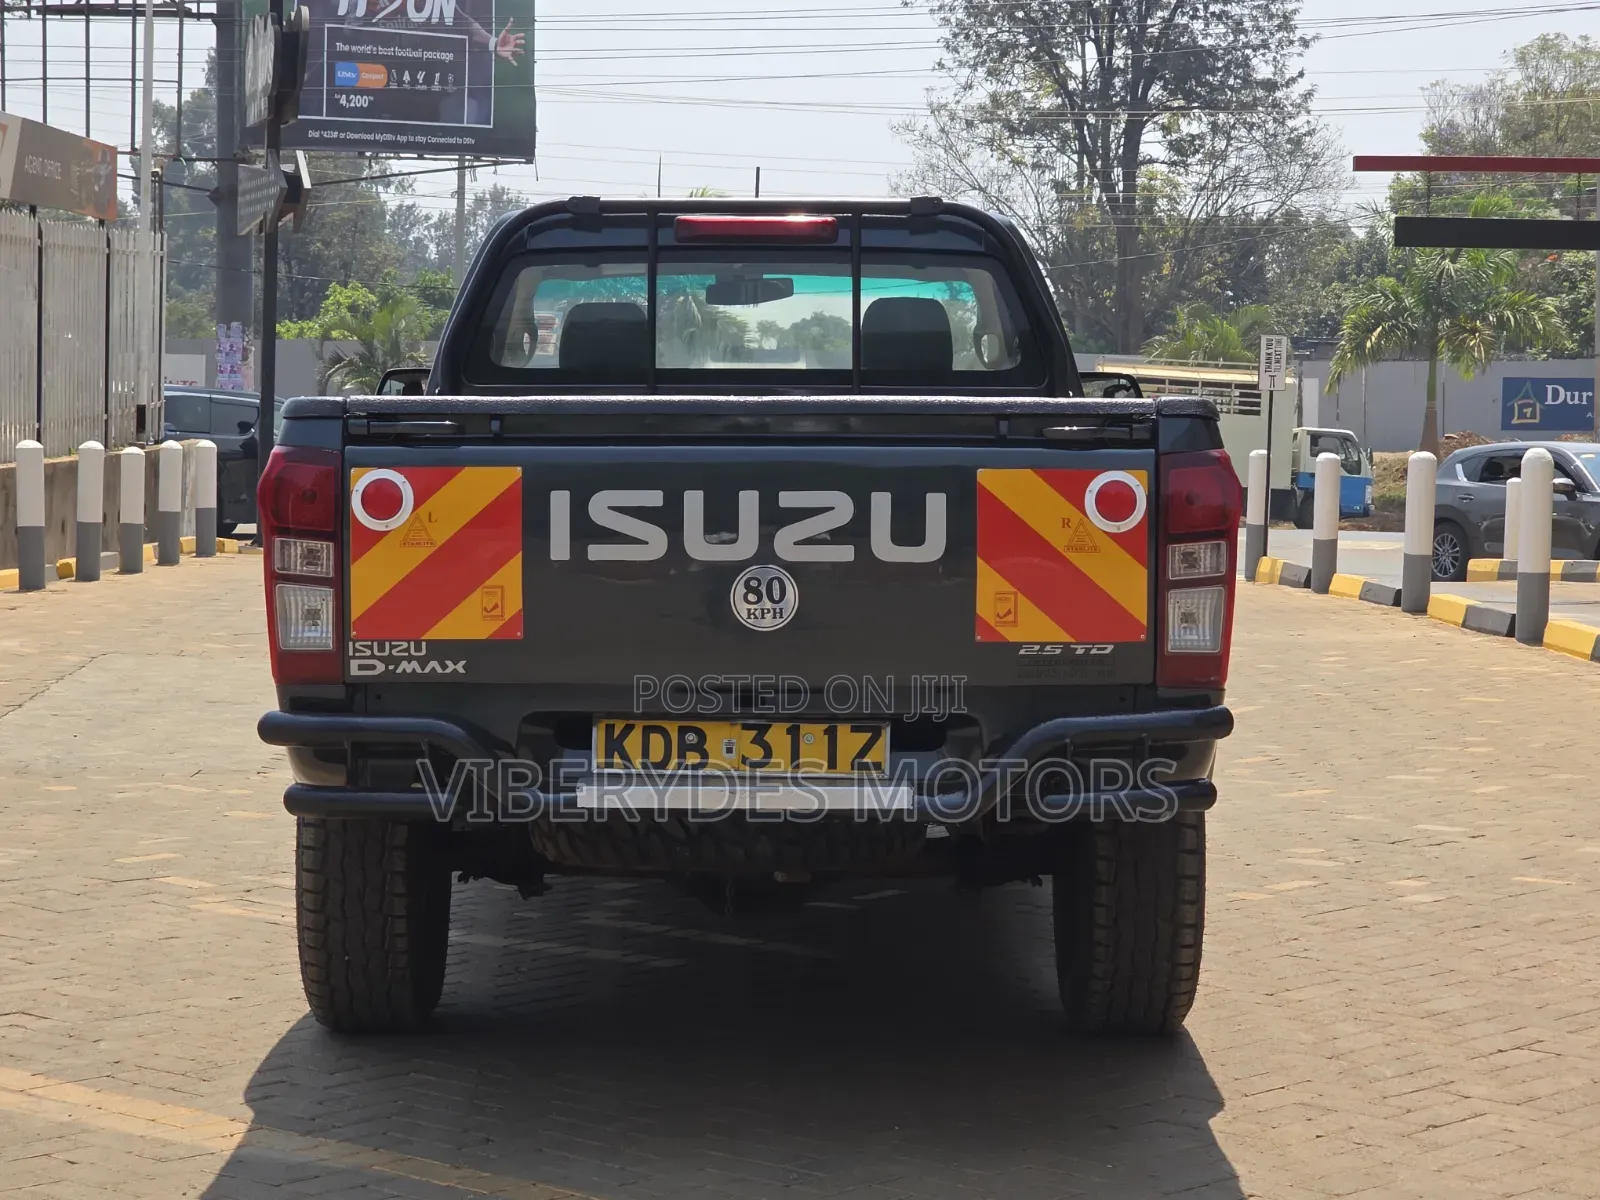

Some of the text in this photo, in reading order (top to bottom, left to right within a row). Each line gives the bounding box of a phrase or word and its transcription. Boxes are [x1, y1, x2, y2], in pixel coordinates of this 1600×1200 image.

[336, 42, 454, 62] The world's best football package
[340, 93, 369, 109] 4,200
[308, 130, 320, 138] Dial
[346, 131, 375, 140] Download
[375, 133, 396, 142] MyDStv
[397, 134, 408, 143] App
[415, 135, 426, 144] stay
[427, 135, 456, 144] Connected
[463, 137, 475, 145] DStv
[1274, 337, 1283, 349] TIME
[1264, 337, 1273, 373] THANK YOU
[1274, 350, 1282, 364] NEXT
[1544, 384, 1593, 405] Dur
[428, 511, 438, 523] L
[1061, 517, 1072, 529] R
[550, 489, 947, 563] ISUZU
[743, 575, 787, 605] 80
[746, 607, 784, 619] KPH
[348, 641, 426, 657] ISUZU
[1018, 644, 1114, 655] 2.5 TD
[603, 722, 883, 771] KDB 311Z
